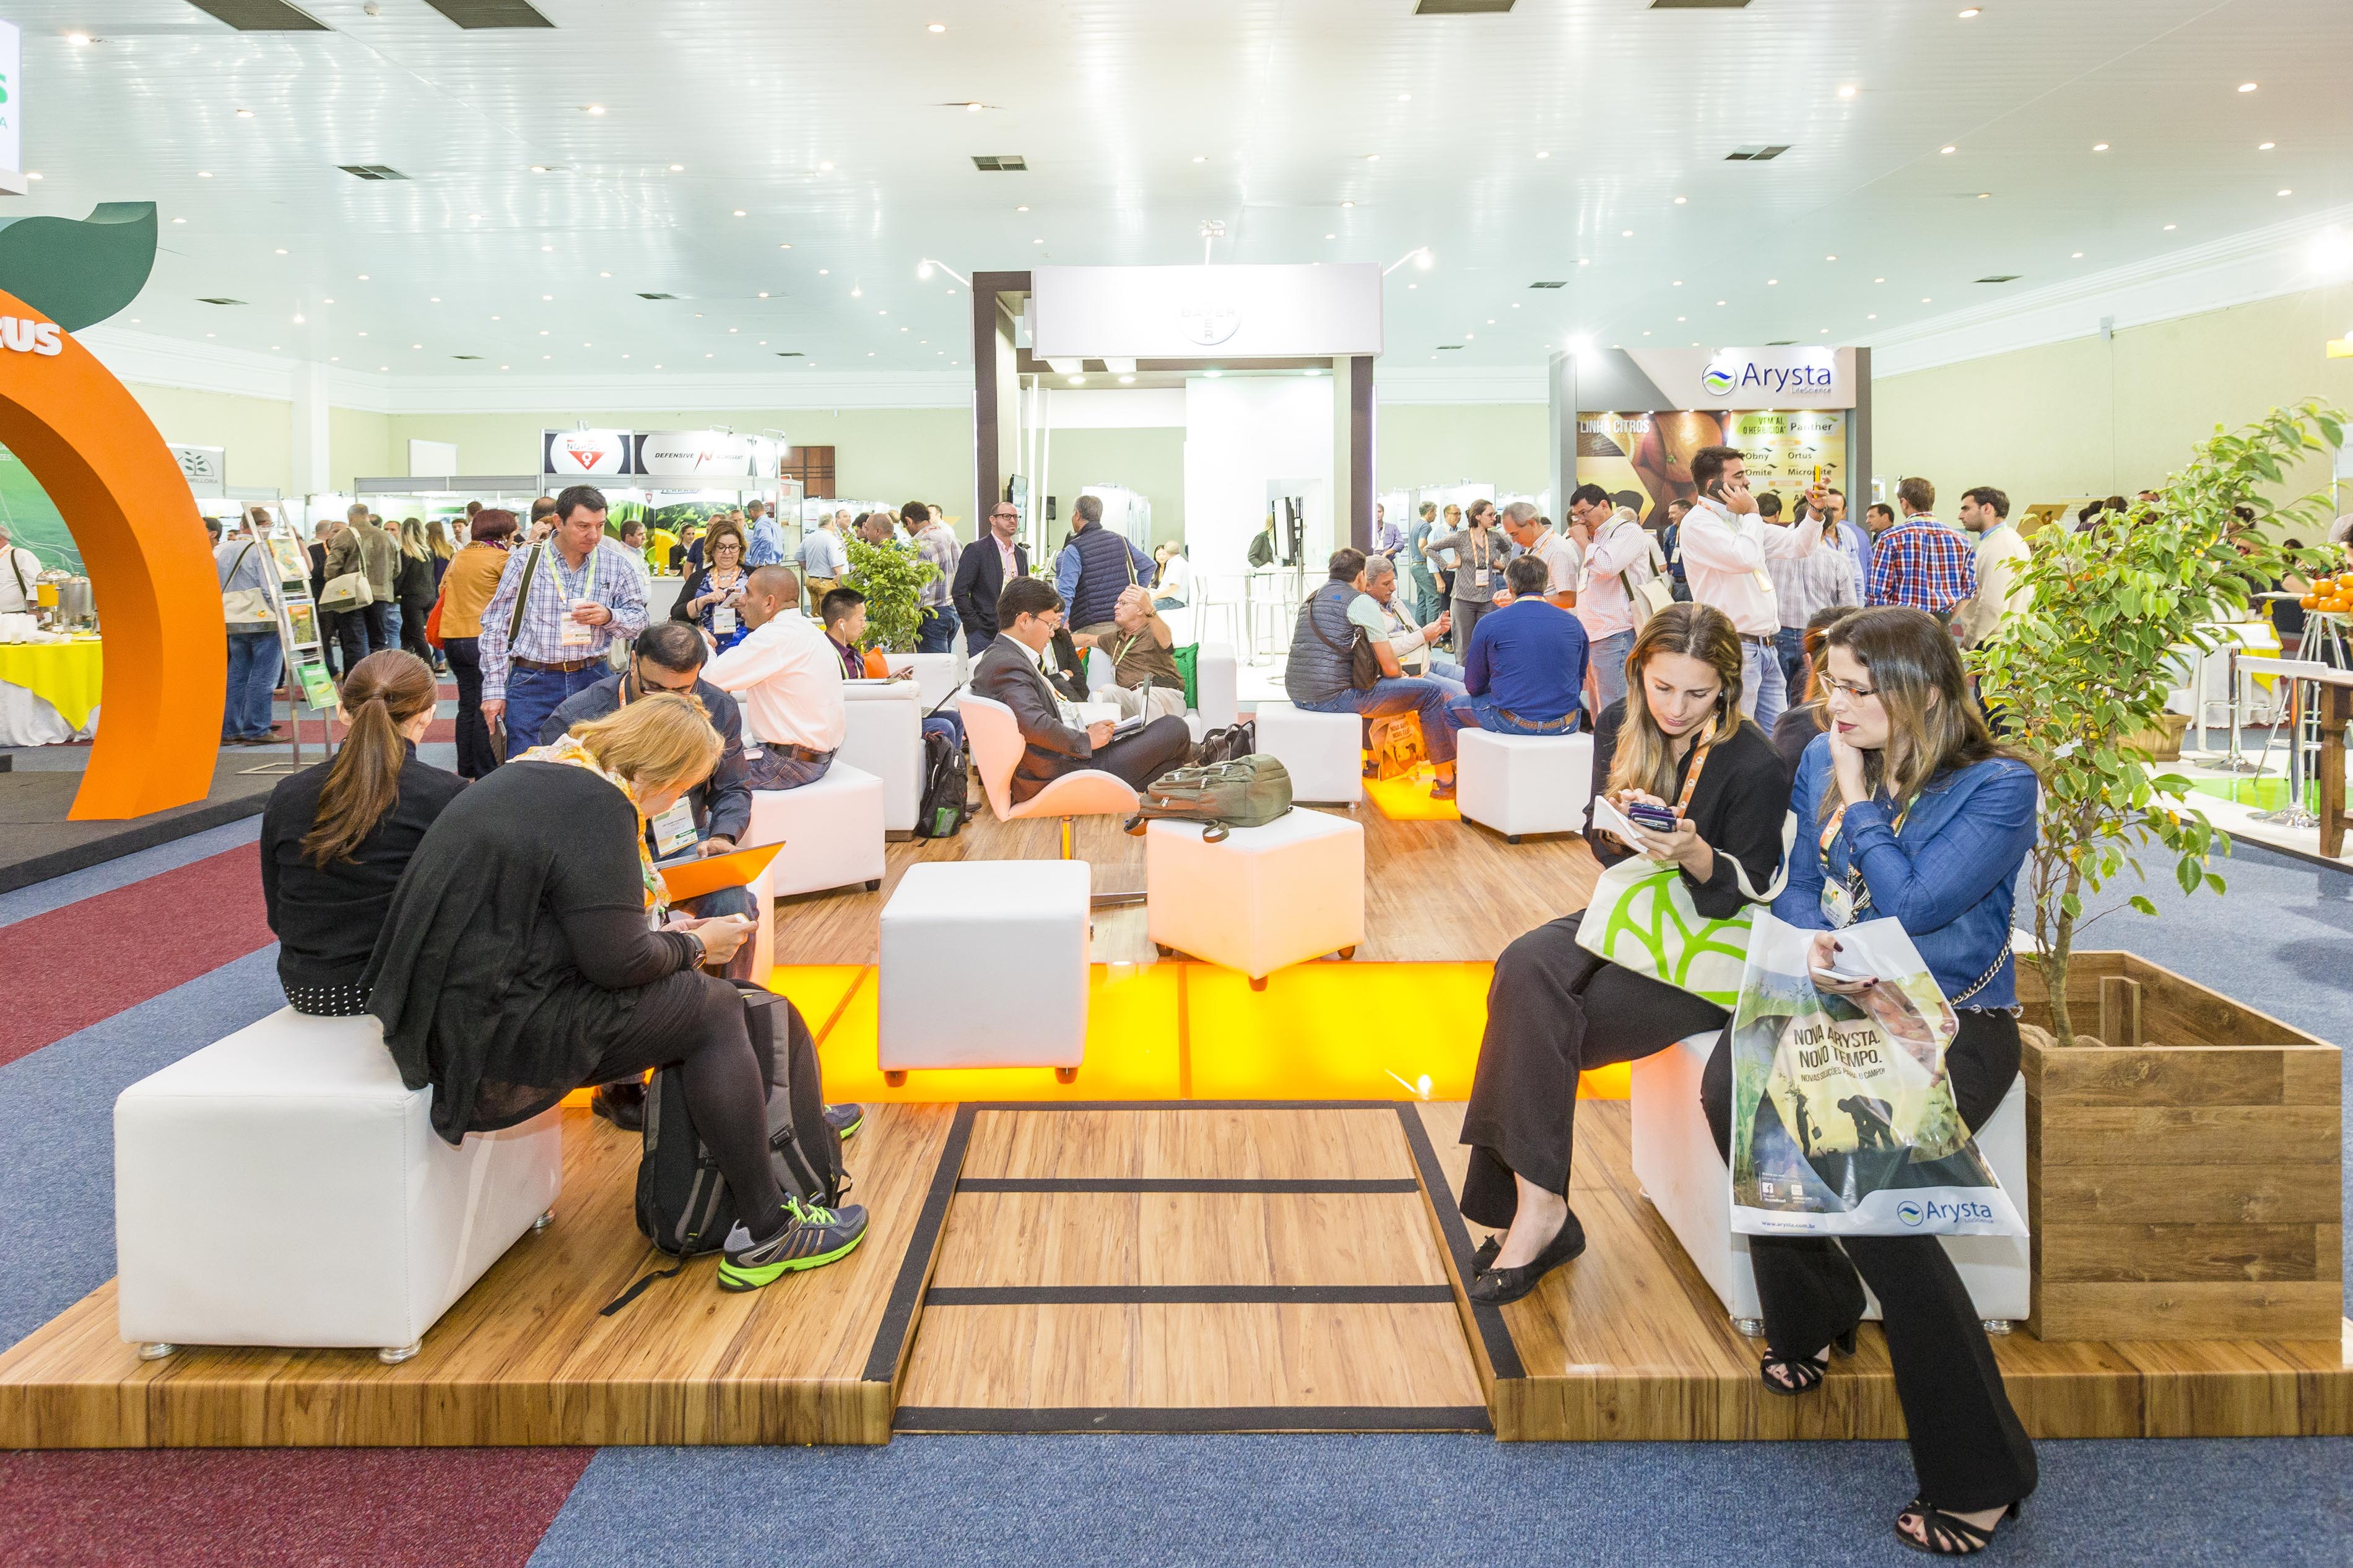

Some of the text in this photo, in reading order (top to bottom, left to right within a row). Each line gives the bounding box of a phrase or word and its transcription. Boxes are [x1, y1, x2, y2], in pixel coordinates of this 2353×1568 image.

[0, 316, 63, 356] US
[1741, 363, 1831, 392] Arysta
[1580, 420, 1650, 433] LINHA CITROS
[1791, 422, 1833, 431] Panther
[1746, 452, 1769, 461] Obny
[1788, 468, 1832, 476] Microite
[1793, 1024, 1881, 1048] NOVA ARYSTA.
[1799, 1045, 1882, 1068] NOVO TEMPO.
[1801, 1073, 1821, 1082] NOVAS
[1927, 1200, 1992, 1223] Arysta
[1762, 1221, 1815, 1229] www.arysta.com.br
